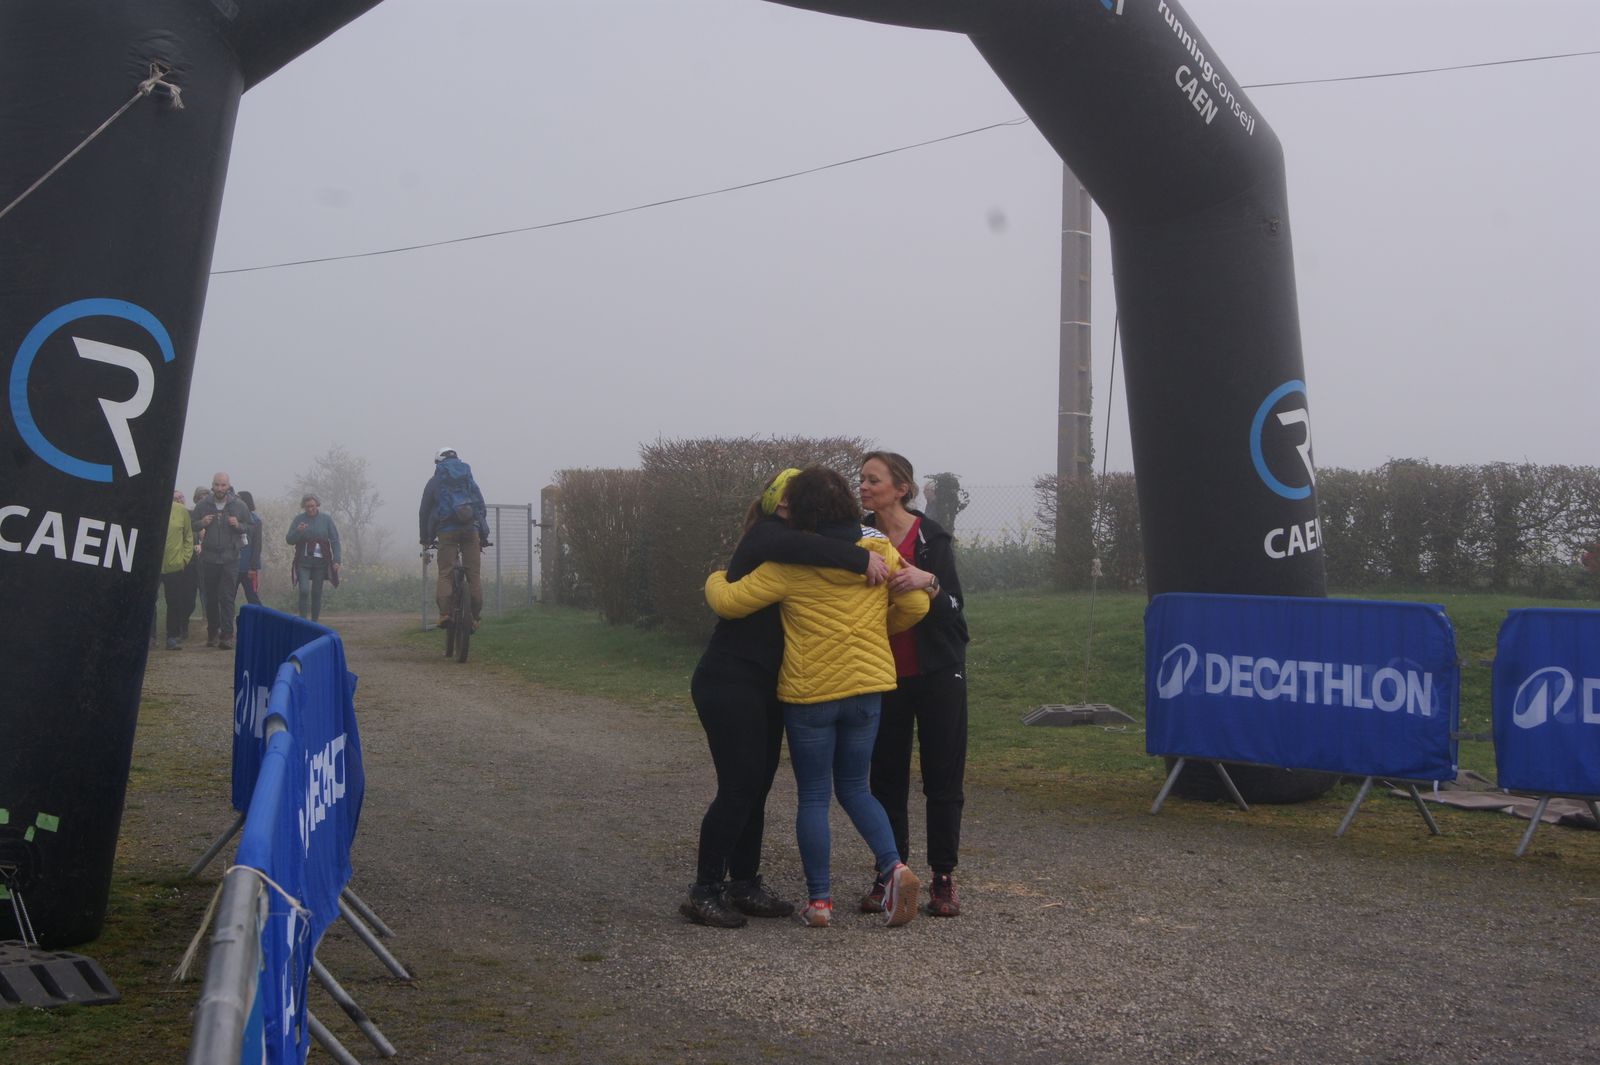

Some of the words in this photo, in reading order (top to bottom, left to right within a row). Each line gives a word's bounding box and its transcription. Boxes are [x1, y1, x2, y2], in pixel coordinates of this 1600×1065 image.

[1174, 64, 1219, 125] CAEN
[0, 504, 139, 573] CAEN
[1205, 652, 1433, 717] DECATHLON
